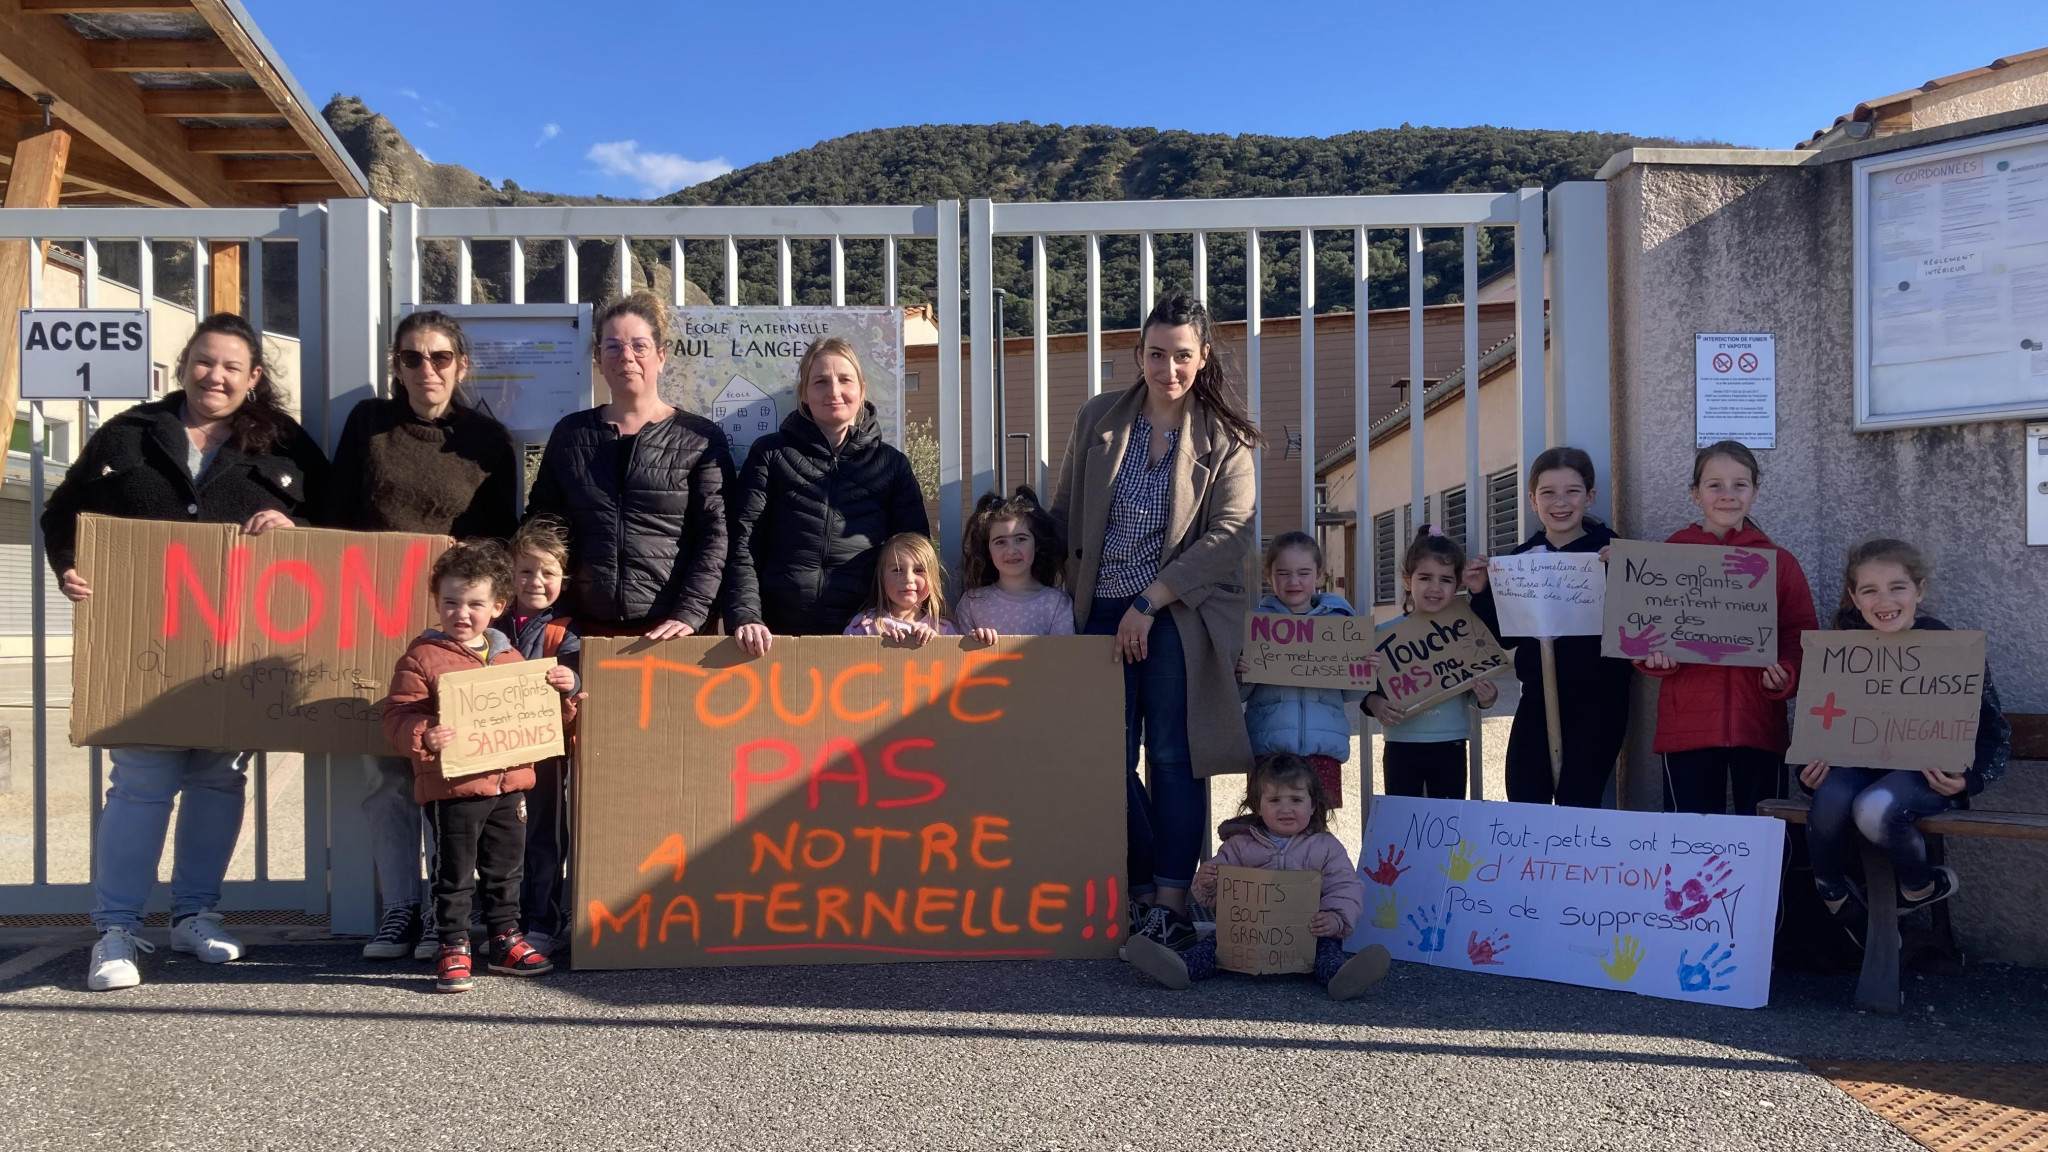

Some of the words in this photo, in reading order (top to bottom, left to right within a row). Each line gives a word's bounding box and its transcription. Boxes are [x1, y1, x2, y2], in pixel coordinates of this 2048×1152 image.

[25, 321, 143, 351] ACCES
[685, 317, 728, 335] ÉCOLE
[740, 323, 829, 335] MATERNELLE
[76, 362, 91, 392] 1
[1625, 558, 1668, 587] Nos
[1675, 565, 1743, 597] enfants
[161, 540, 430, 651] NON
[1645, 592, 1721, 610] méritent
[1725, 600, 1769, 613] mieux
[1251, 615, 1315, 645] NON
[1322, 626, 1335, 641] à
[1343, 620, 1365, 642] la
[1627, 612, 1663, 631] que
[1674, 610, 1706, 626] des
[597, 652, 1026, 729] TOUCHE
[1388, 665, 1433, 701] PAS
[1433, 657, 1464, 676] ma
[1865, 679, 1894, 695] DE
[1900, 673, 1980, 695] CLASSE
[459, 683, 502, 718] Nos
[503, 674, 549, 711] enfants
[473, 718, 486, 729] ne
[490, 711, 512, 726] sont
[517, 711, 536, 724] pas
[537, 704, 555, 718] des
[730, 737, 949, 823] PAS
[638, 833, 688, 883] A
[749, 814, 1014, 876] NOTRE
[1403, 812, 1461, 850] NOS
[1489, 817, 1612, 856] tout-petits
[1629, 832, 1657, 851] ont
[1670, 833, 1751, 857] besoins
[1222, 877, 1286, 904] PETITS
[1446, 886, 1493, 914] Pas
[1508, 896, 1540, 920] de
[1230, 905, 1271, 924] BOUT
[1229, 924, 1294, 946] GRANDS
